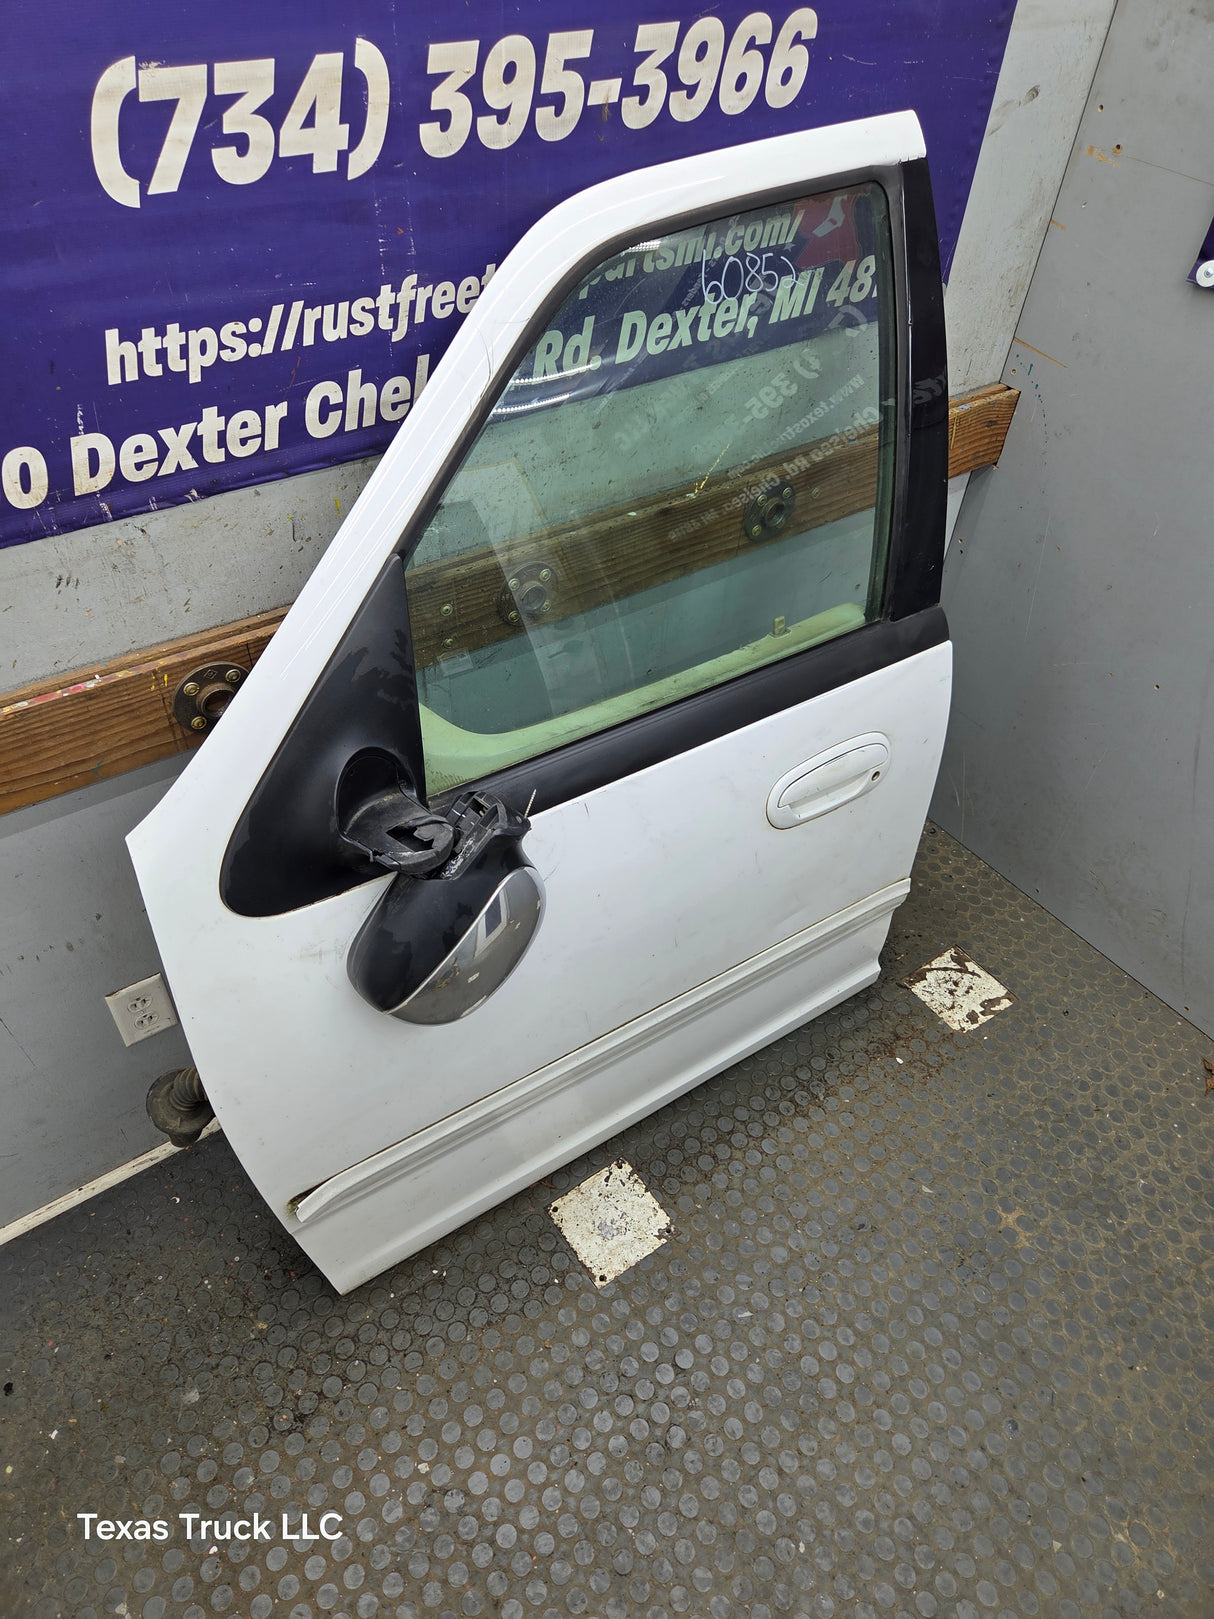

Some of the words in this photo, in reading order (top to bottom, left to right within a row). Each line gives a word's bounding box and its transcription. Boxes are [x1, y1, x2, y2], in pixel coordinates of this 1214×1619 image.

[91, 38, 390, 208] (734)
[419, 8, 818, 158] 395-3966
[70, 401, 288, 497] Dexter
[531, 315, 603, 378] Rd.
[615, 289, 758, 364] Dexter,
[769, 267, 825, 324] MI
